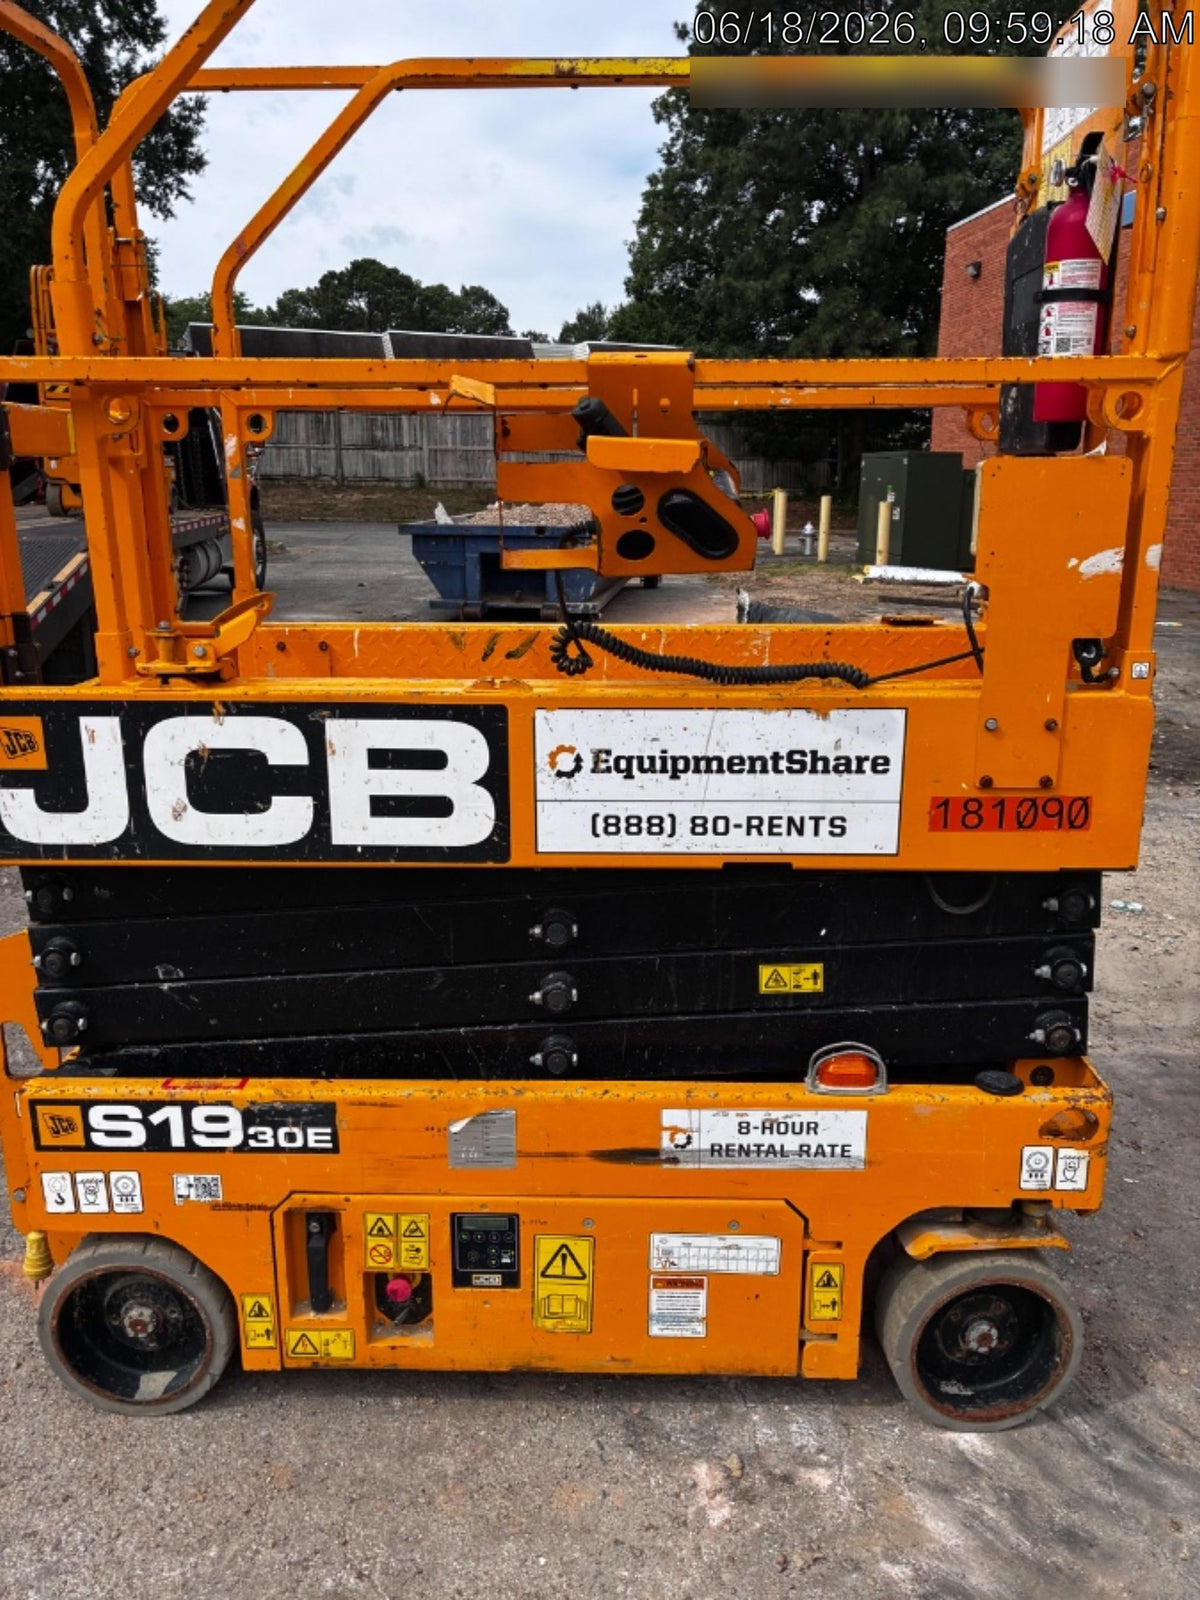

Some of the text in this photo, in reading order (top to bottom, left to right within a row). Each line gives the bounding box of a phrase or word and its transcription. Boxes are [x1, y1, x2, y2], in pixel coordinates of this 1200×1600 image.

[2, 730, 37, 756] JCB
[590, 749, 891, 780] EquipmentShare
[0, 716, 496, 847] JCB
[591, 813, 848, 838] (888) 80-RENTS
[935, 797, 1090, 830] 181090
[737, 1120, 819, 1136] 8-HOUR
[710, 1143, 852, 1158] RENTAL RATE
